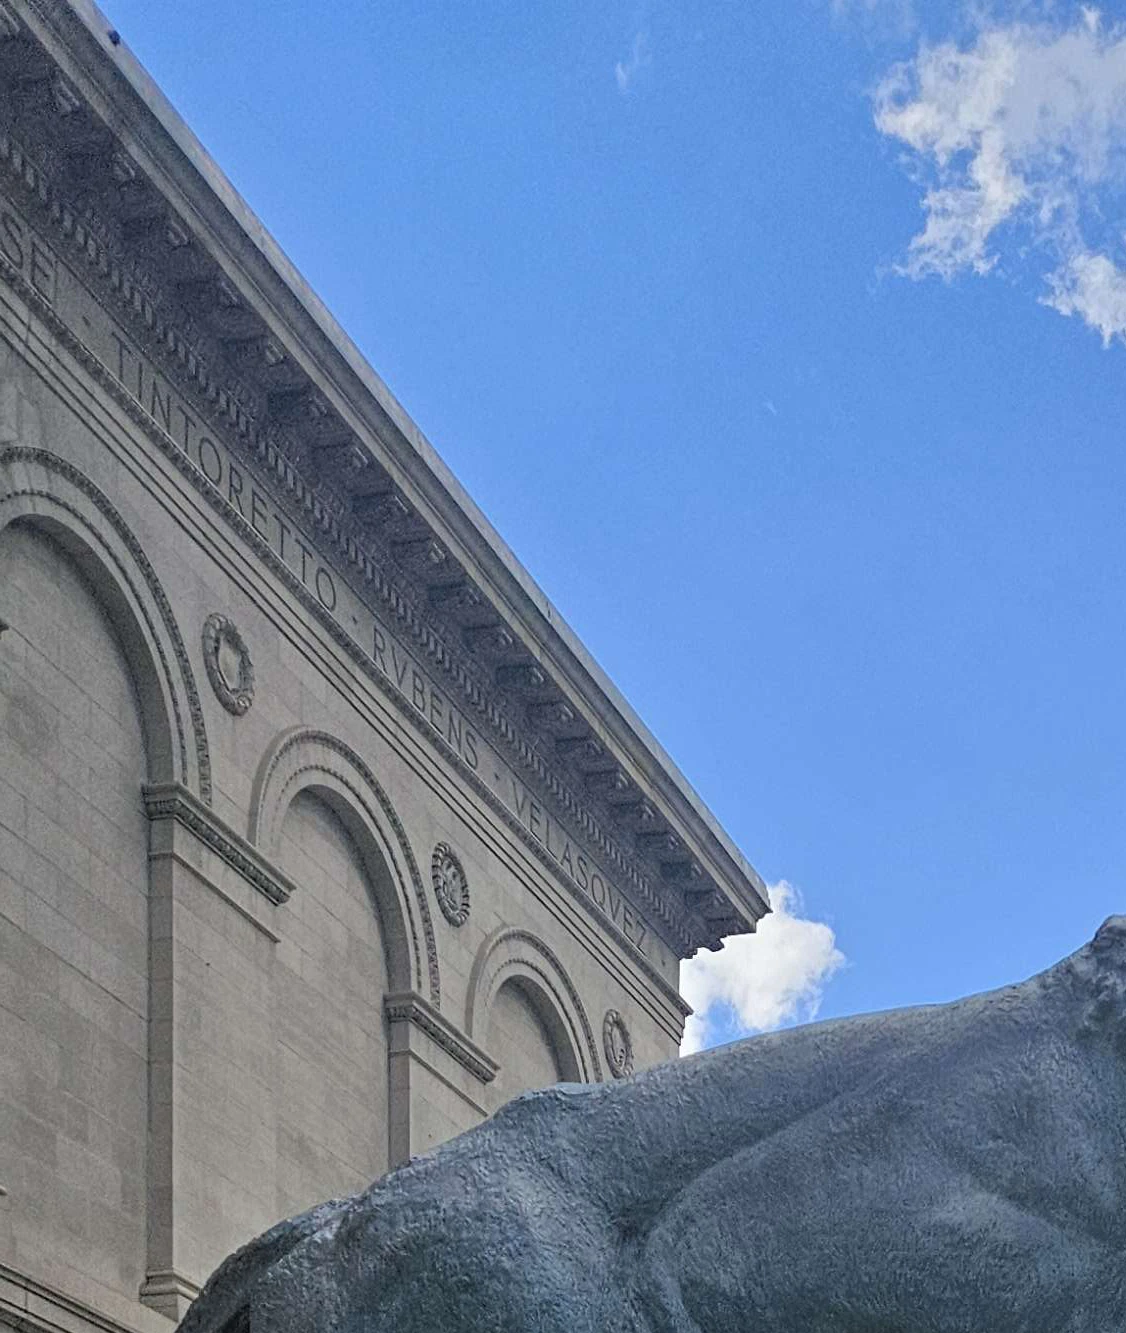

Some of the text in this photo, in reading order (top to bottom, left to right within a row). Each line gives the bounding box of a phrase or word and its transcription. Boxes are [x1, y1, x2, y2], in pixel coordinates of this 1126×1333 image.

[111, 330, 336, 612] TINTORETTO
[373, 624, 478, 770] RVBENS
[512, 781, 647, 957] VELASQVEZ
